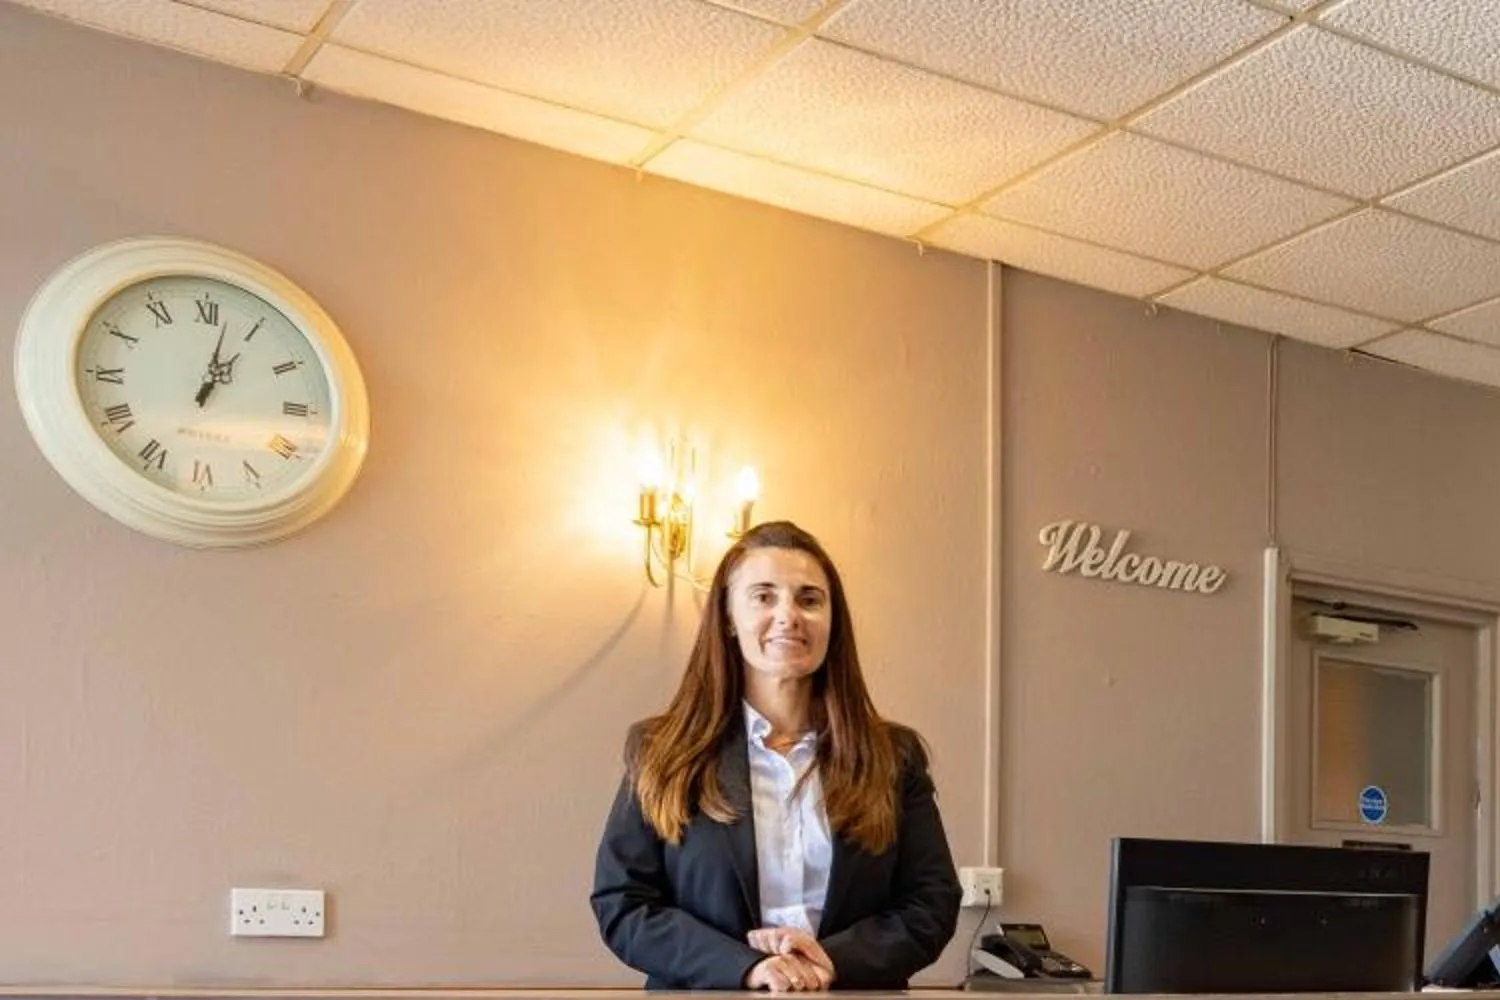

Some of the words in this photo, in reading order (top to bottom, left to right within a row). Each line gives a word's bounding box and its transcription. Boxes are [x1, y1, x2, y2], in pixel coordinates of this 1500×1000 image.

[146, 301, 173, 328] XI
[194, 299, 219, 326] XII
[272, 361, 297, 375] II
[283, 401, 309, 416] III
[1039, 520, 1227, 594] Welcome
